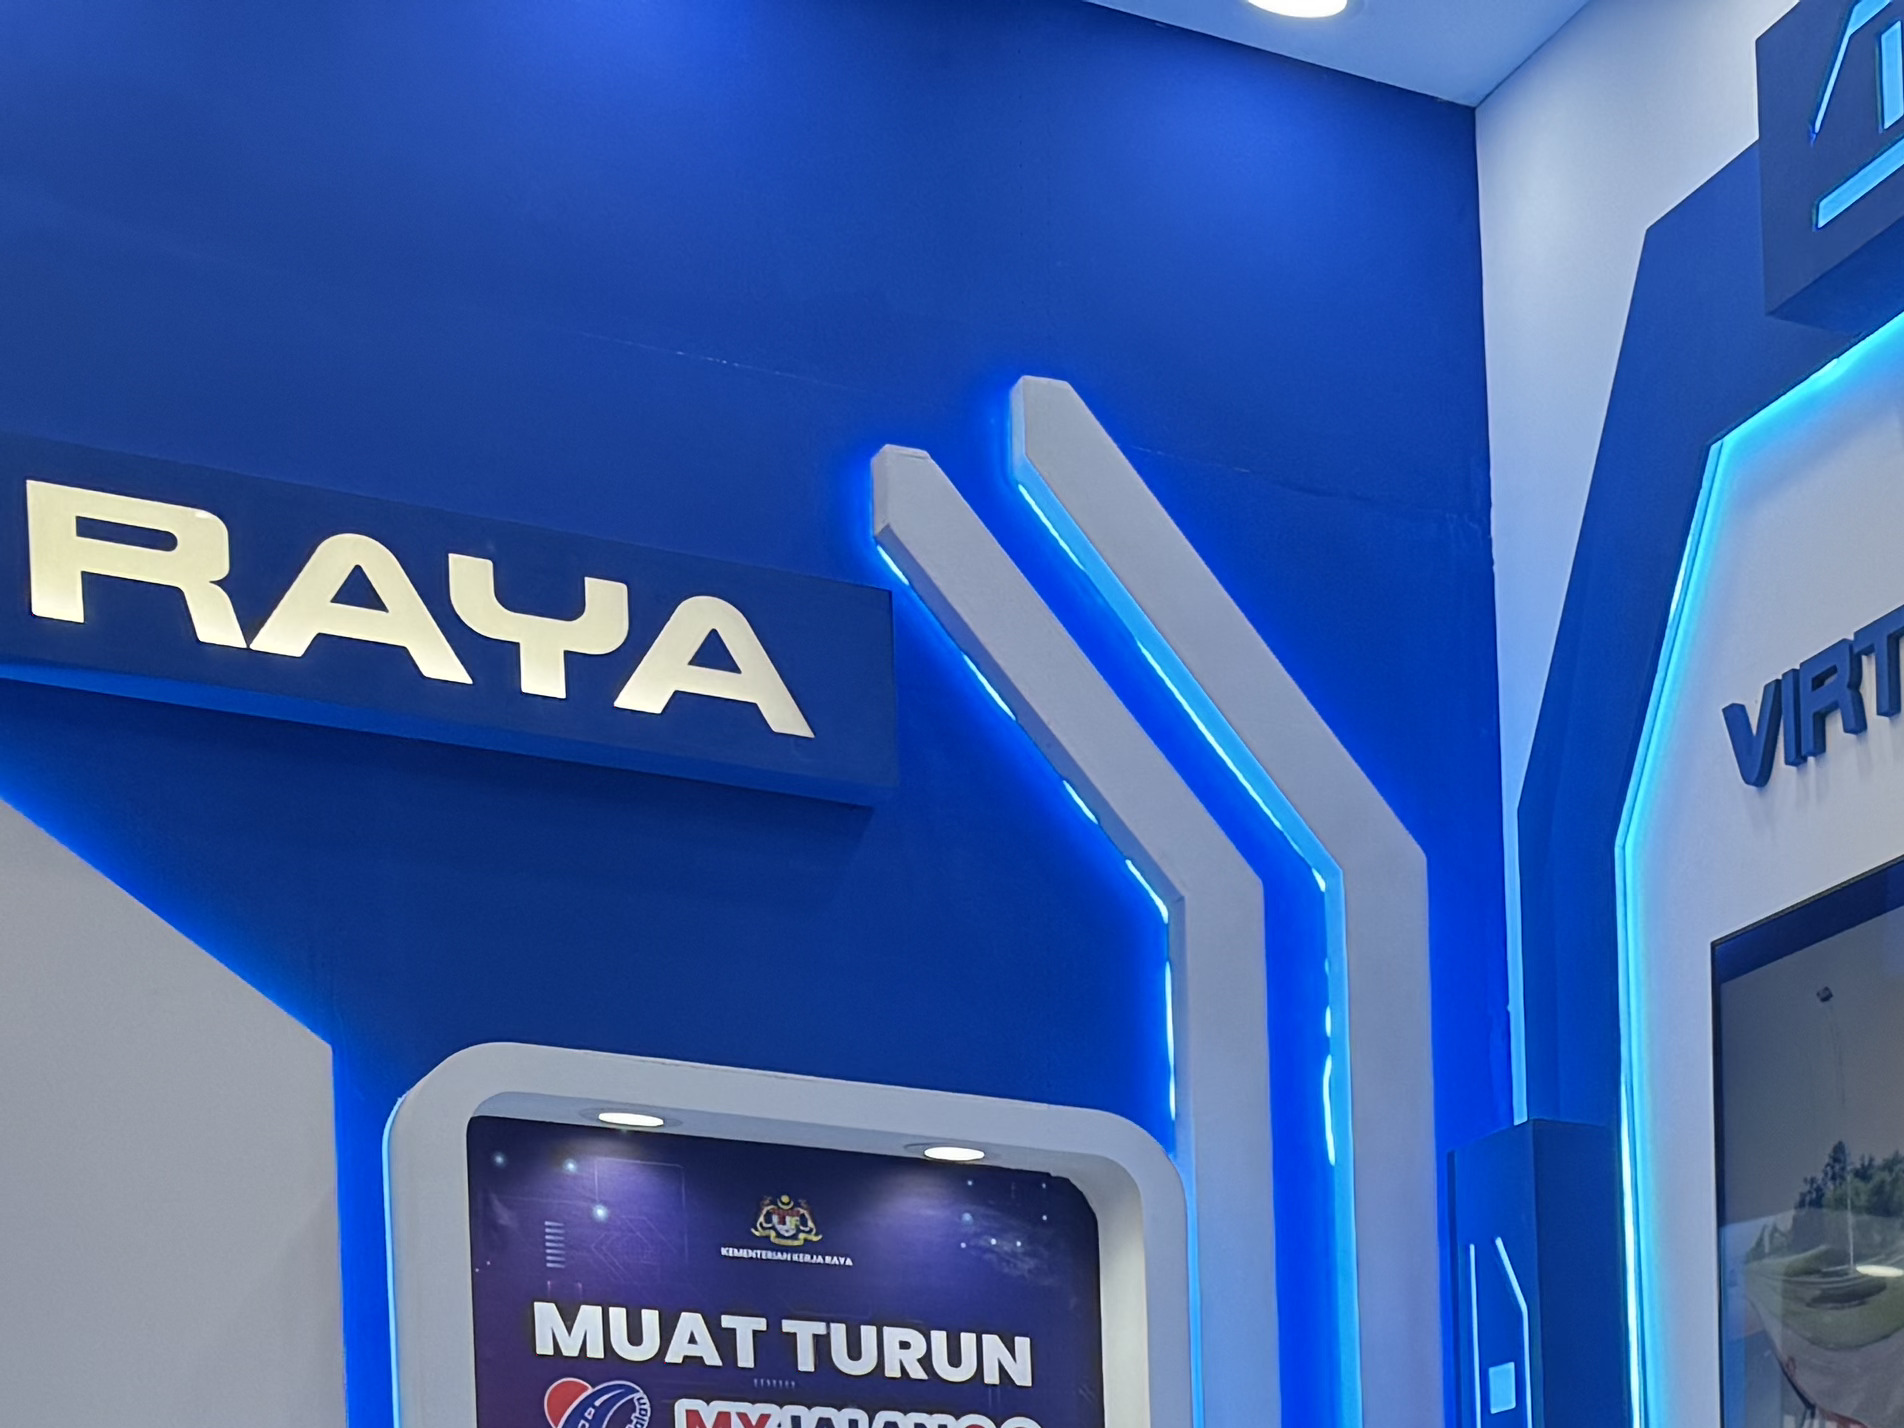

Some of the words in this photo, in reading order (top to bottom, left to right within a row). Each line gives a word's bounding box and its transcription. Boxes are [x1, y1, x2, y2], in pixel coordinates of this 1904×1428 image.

[26, 479, 815, 738] RAYA
[533, 1300, 767, 1369] MUAT
[782, 1322, 1033, 1388] TURUN
